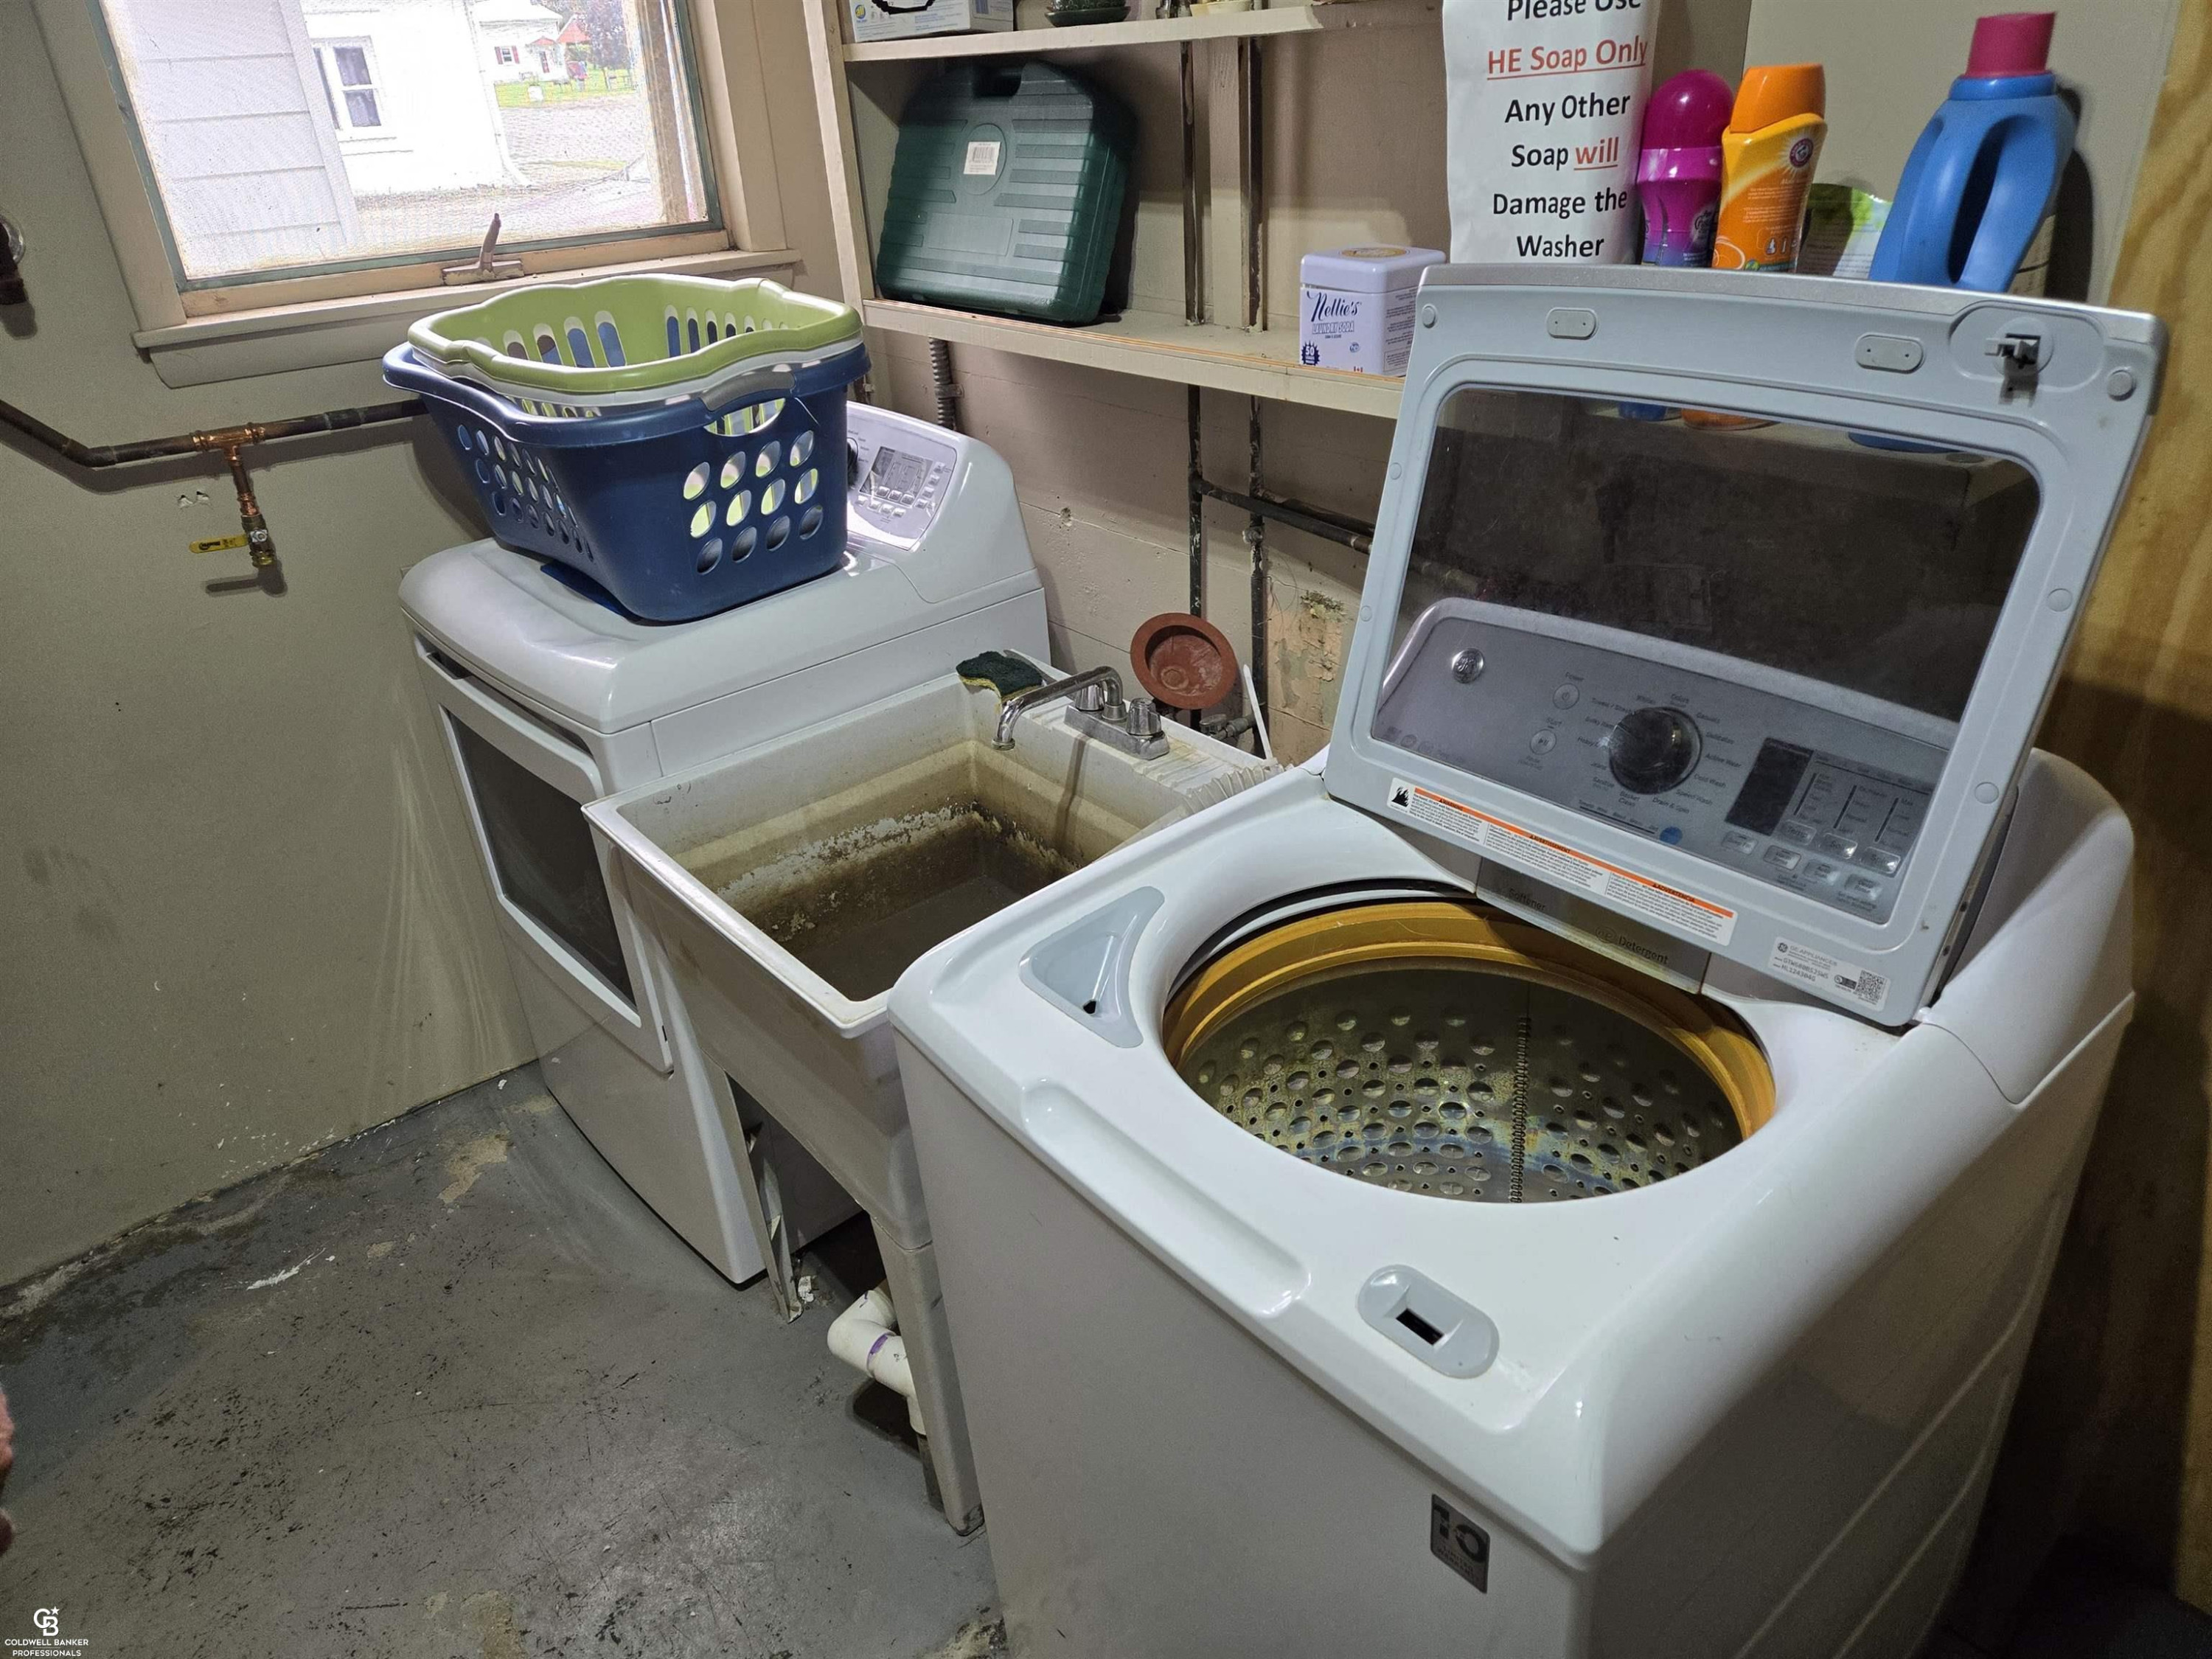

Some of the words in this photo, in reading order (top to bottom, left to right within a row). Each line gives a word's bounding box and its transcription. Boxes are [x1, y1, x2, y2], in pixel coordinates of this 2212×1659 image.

[1507, 0, 1585, 21] Please
[1595, 0, 1641, 12] Use
[1488, 49, 1522, 74] HE
[1530, 46, 1587, 72] Soap
[1596, 35, 1648, 66] Only
[1504, 99, 1555, 125] Any
[1561, 92, 1631, 119] Other
[1511, 145, 1569, 170] Soap
[1575, 136, 1619, 165] will
[1493, 193, 1585, 219] Damage
[1594, 187, 1627, 212] the
[1517, 234, 1604, 257] Washer
[1306, 291, 1360, 322] Nellie's
[1338, 321, 1354, 333] SODA
[1305, 346, 1315, 355] 50
[1509, 888, 1546, 911] Softener
[1618, 935, 1669, 965] Detergent
